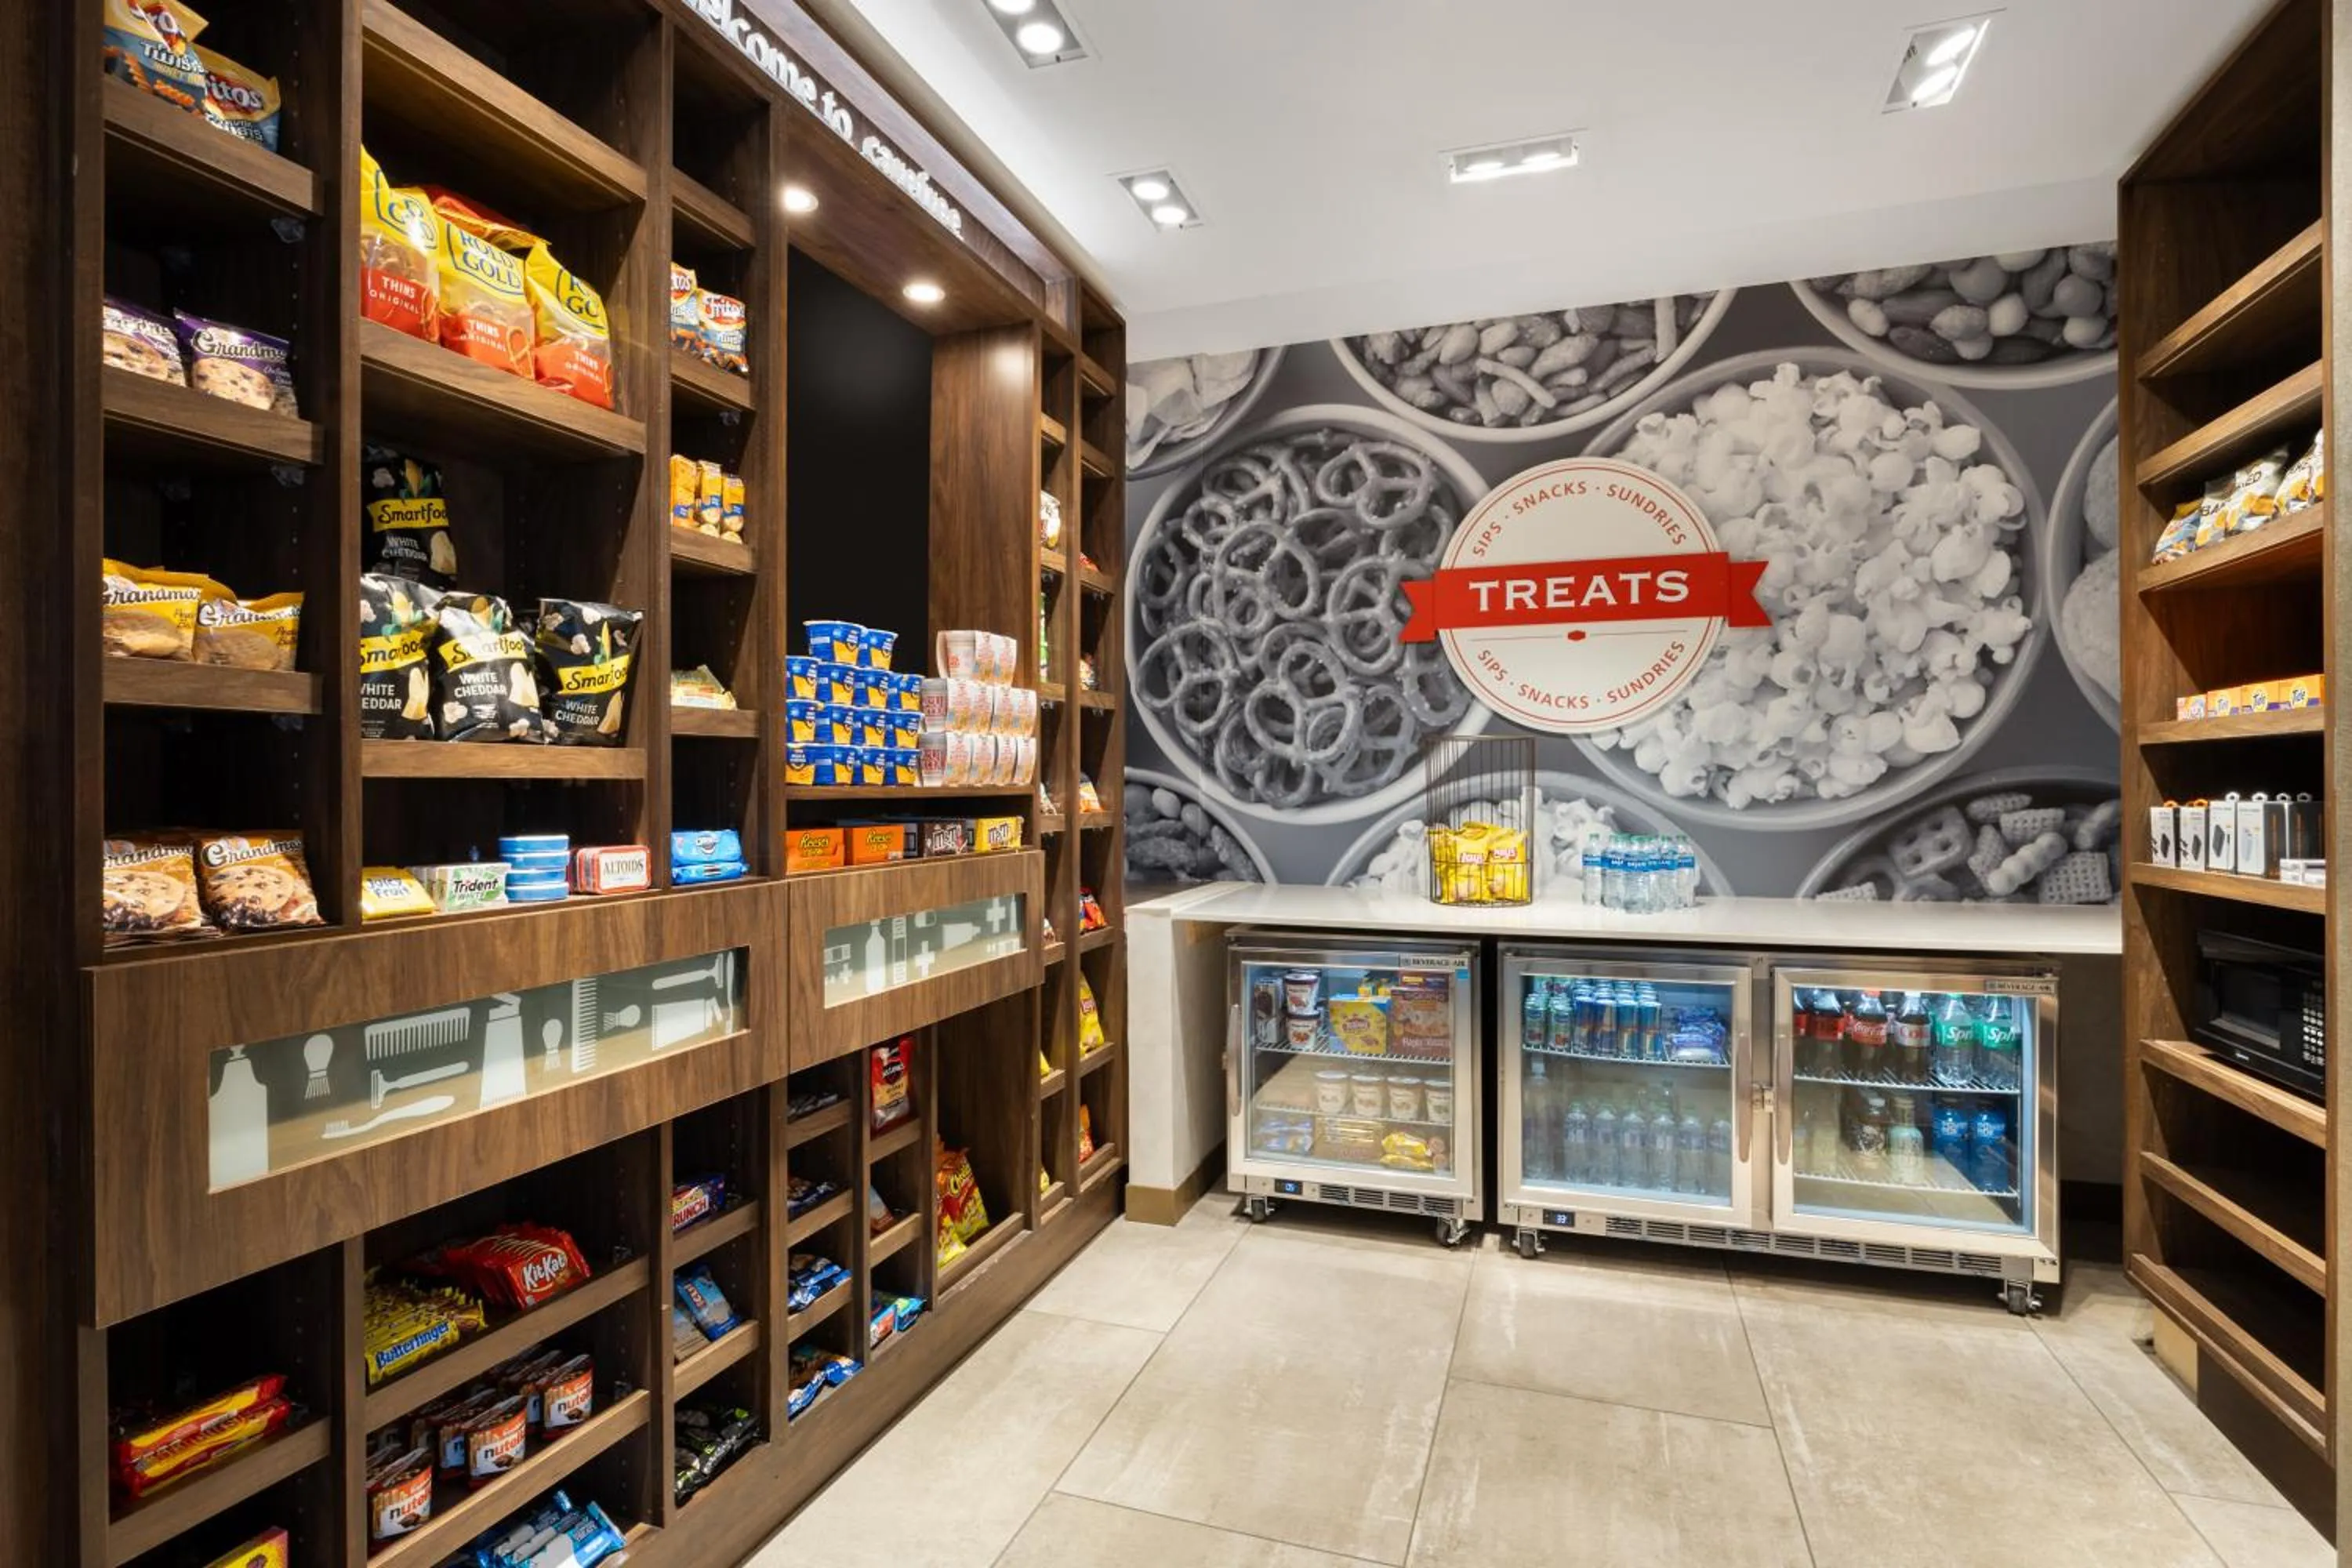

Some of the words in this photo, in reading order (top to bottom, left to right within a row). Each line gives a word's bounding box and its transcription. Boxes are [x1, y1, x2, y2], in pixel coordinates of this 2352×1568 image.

[822, 92, 853, 141] to
[382, 276, 416, 299] THINS
[368, 289, 419, 314] ORIGINAL
[467, 319, 500, 339] THINS
[377, 503, 448, 526] Smartfoo
[1472, 521, 1502, 557] SIPS
[1512, 481, 1588, 514] SNACKS
[1606, 483, 1687, 546] SUNDRIES
[386, 535, 420, 550] WHITE
[382, 548, 428, 563] CHEDDAR
[1468, 571, 1690, 612] TREATS
[459, 672, 499, 684] WHITE
[1478, 649, 1508, 682] SIPS
[1518, 684, 1590, 710] SNACKS
[1607, 640, 1686, 704] SUNDRIES
[454, 684, 509, 699] CHEDDAR
[361, 697, 402, 710] EDDAR
[565, 699, 598, 714] WHITE
[555, 710, 600, 725] CHEDDAR
[603, 858, 644, 876] ALTOIDS
[454, 879, 499, 893] Trident
[376, 1320, 450, 1368] Butterfinger
